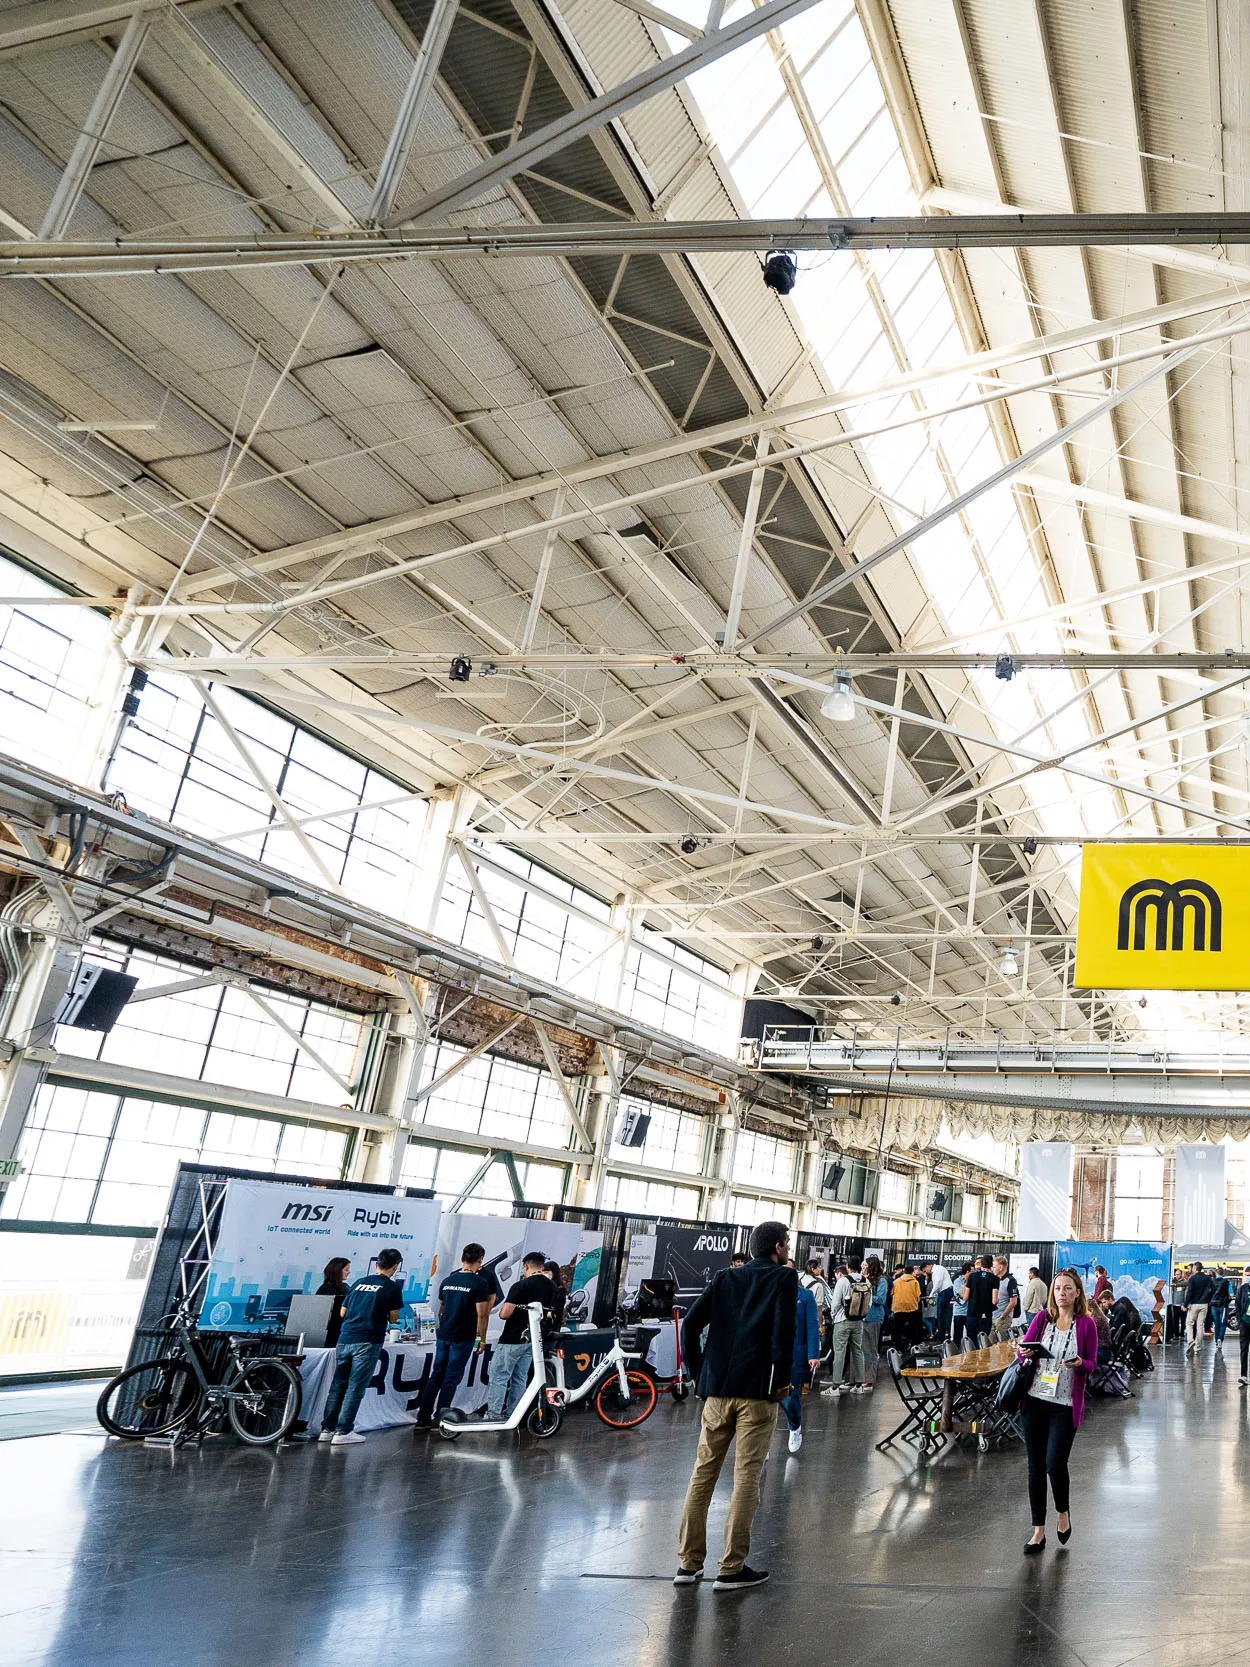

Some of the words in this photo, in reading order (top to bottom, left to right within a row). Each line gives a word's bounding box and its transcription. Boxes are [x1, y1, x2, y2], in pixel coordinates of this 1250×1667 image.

[0, 1161, 20, 1175] EXIT
[281, 1203, 334, 1222] msi
[354, 1208, 401, 1228] Rybit
[693, 1235, 729, 1251] APOLLO
[355, 1284, 382, 1292] msi
